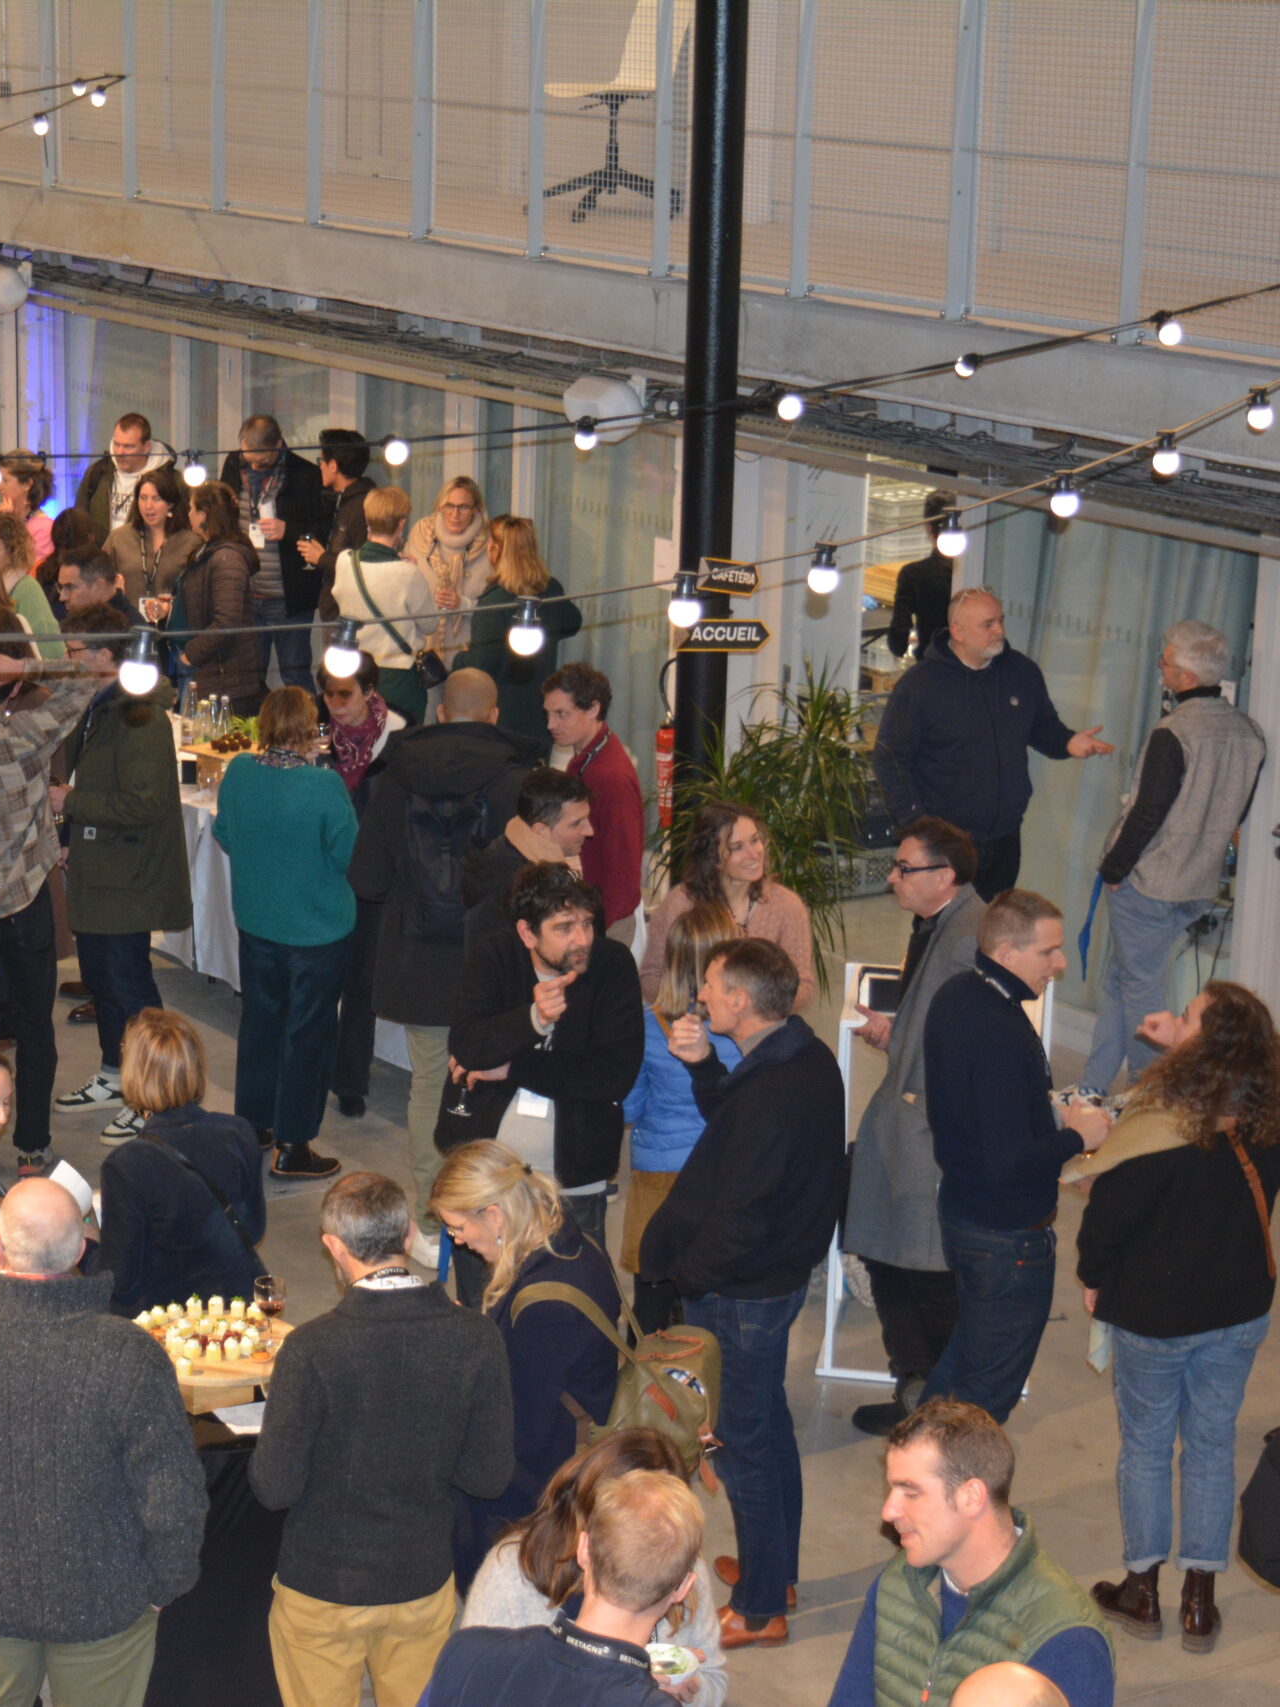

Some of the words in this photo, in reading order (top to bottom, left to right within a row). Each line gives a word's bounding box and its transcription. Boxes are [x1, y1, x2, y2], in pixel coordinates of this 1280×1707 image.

[711, 567, 755, 585] CAFETÉRIA
[690, 626, 761, 642] ACCUEIL
[565, 1635, 604, 1656] BRETAGNE
